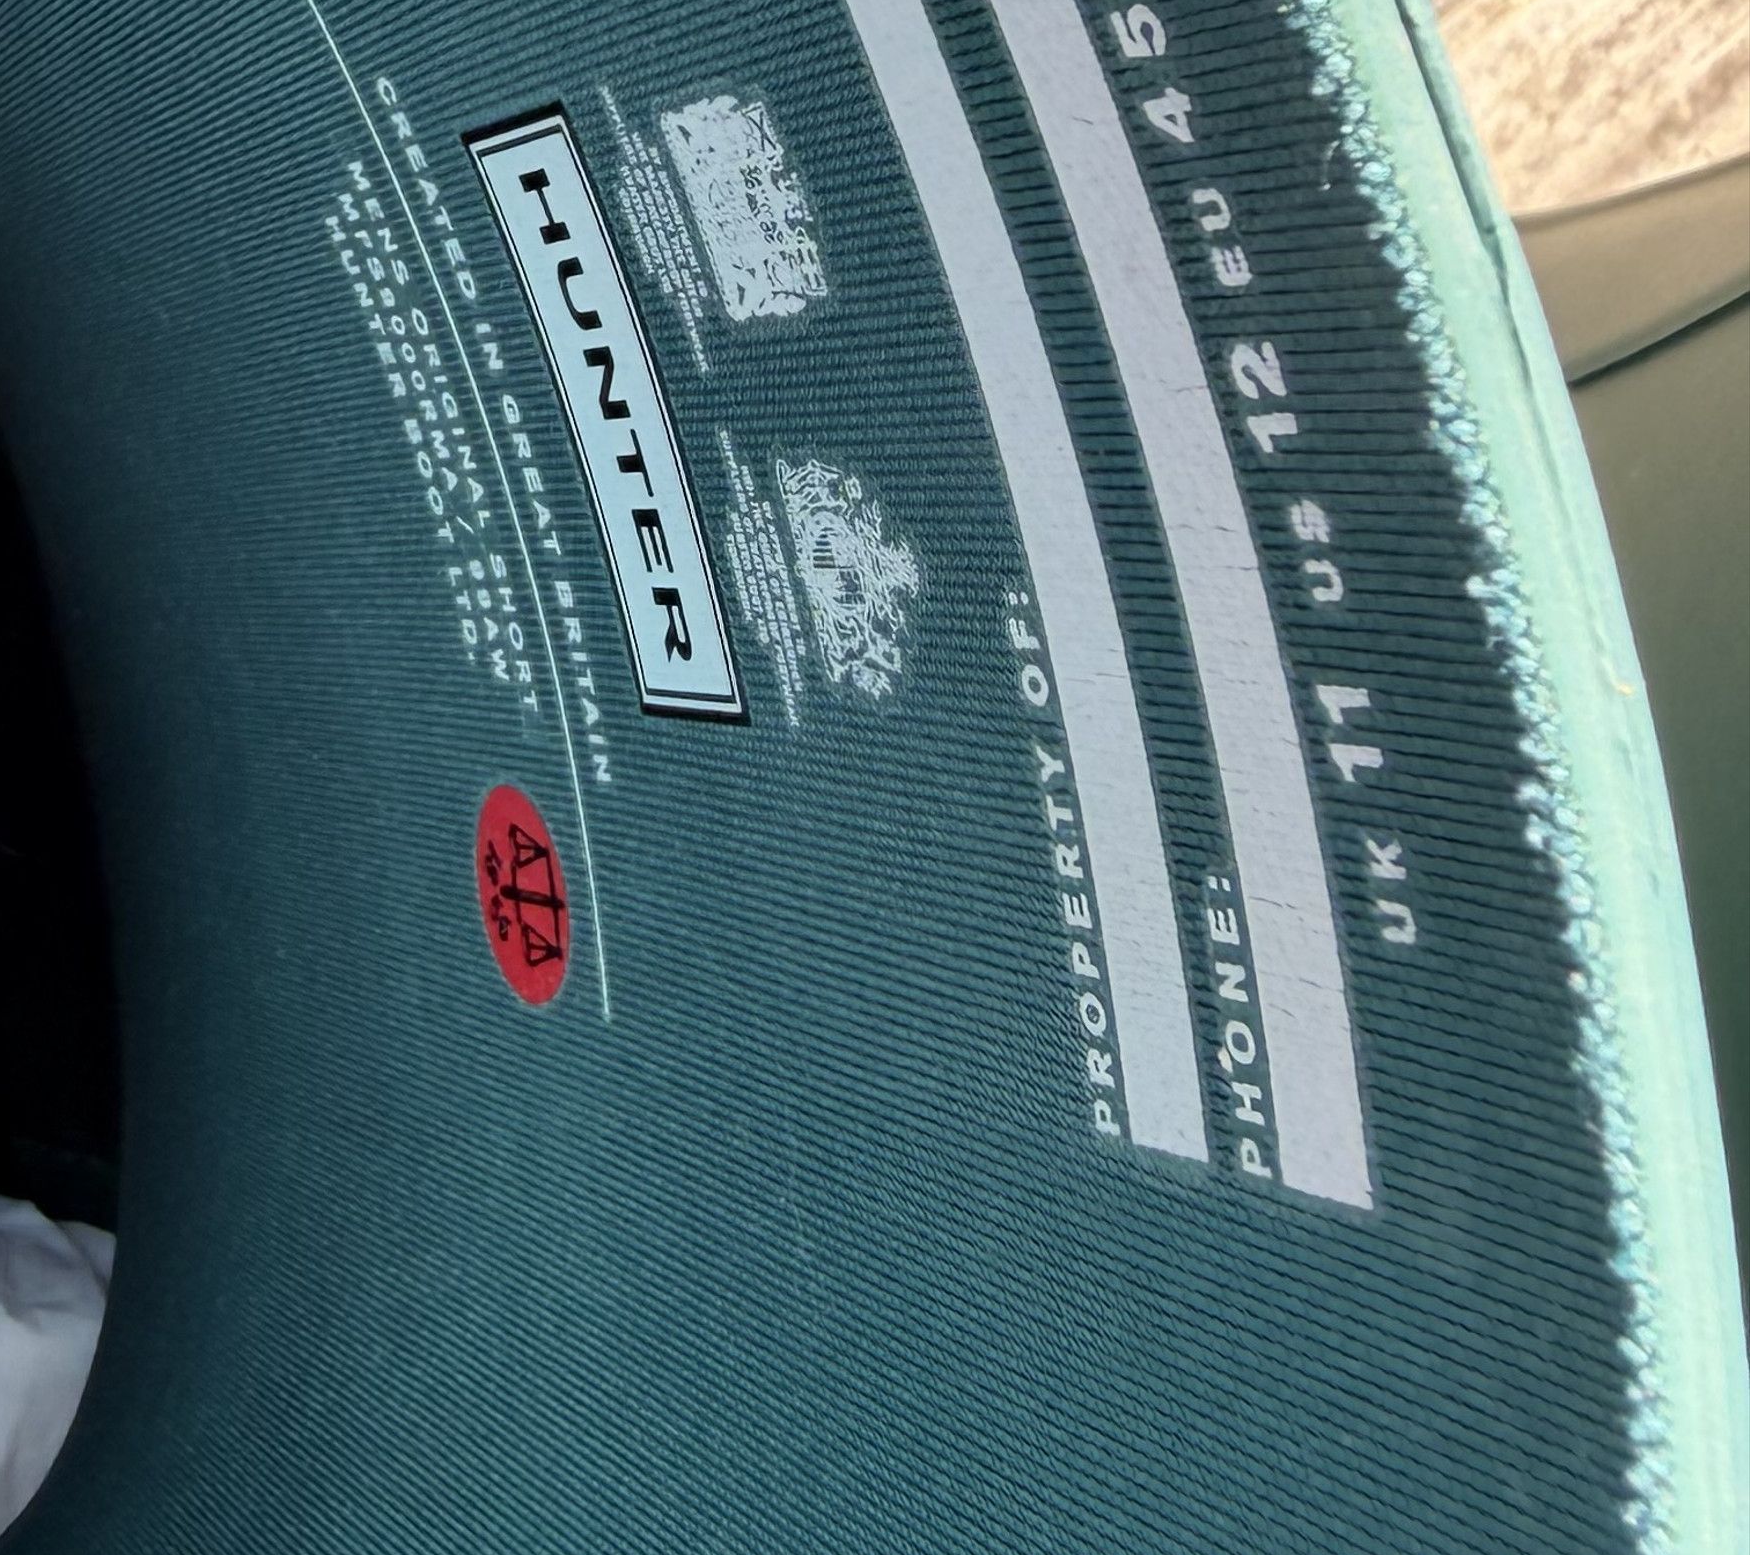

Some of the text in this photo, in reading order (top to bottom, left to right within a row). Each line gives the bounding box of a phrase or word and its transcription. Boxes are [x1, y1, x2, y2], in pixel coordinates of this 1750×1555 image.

[1189, 186, 1252, 286] EU
[325, 215, 478, 666] HUNTER BOOT LTD.
[348, 161, 539, 713] MENS ORIGINAL SHORT
[376, 77, 612, 782] CREATED IN GREAT BRITAIN
[518, 168, 693, 663] HUNTER
[1229, 339, 1299, 453] 12
[1288, 502, 1343, 601] US
[1007, 591, 1120, 1133] PROPERTY OF:
[1314, 685, 1385, 782] 11
[1205, 874, 1272, 1177] PHONE:
[1364, 840, 1417, 943] UK
